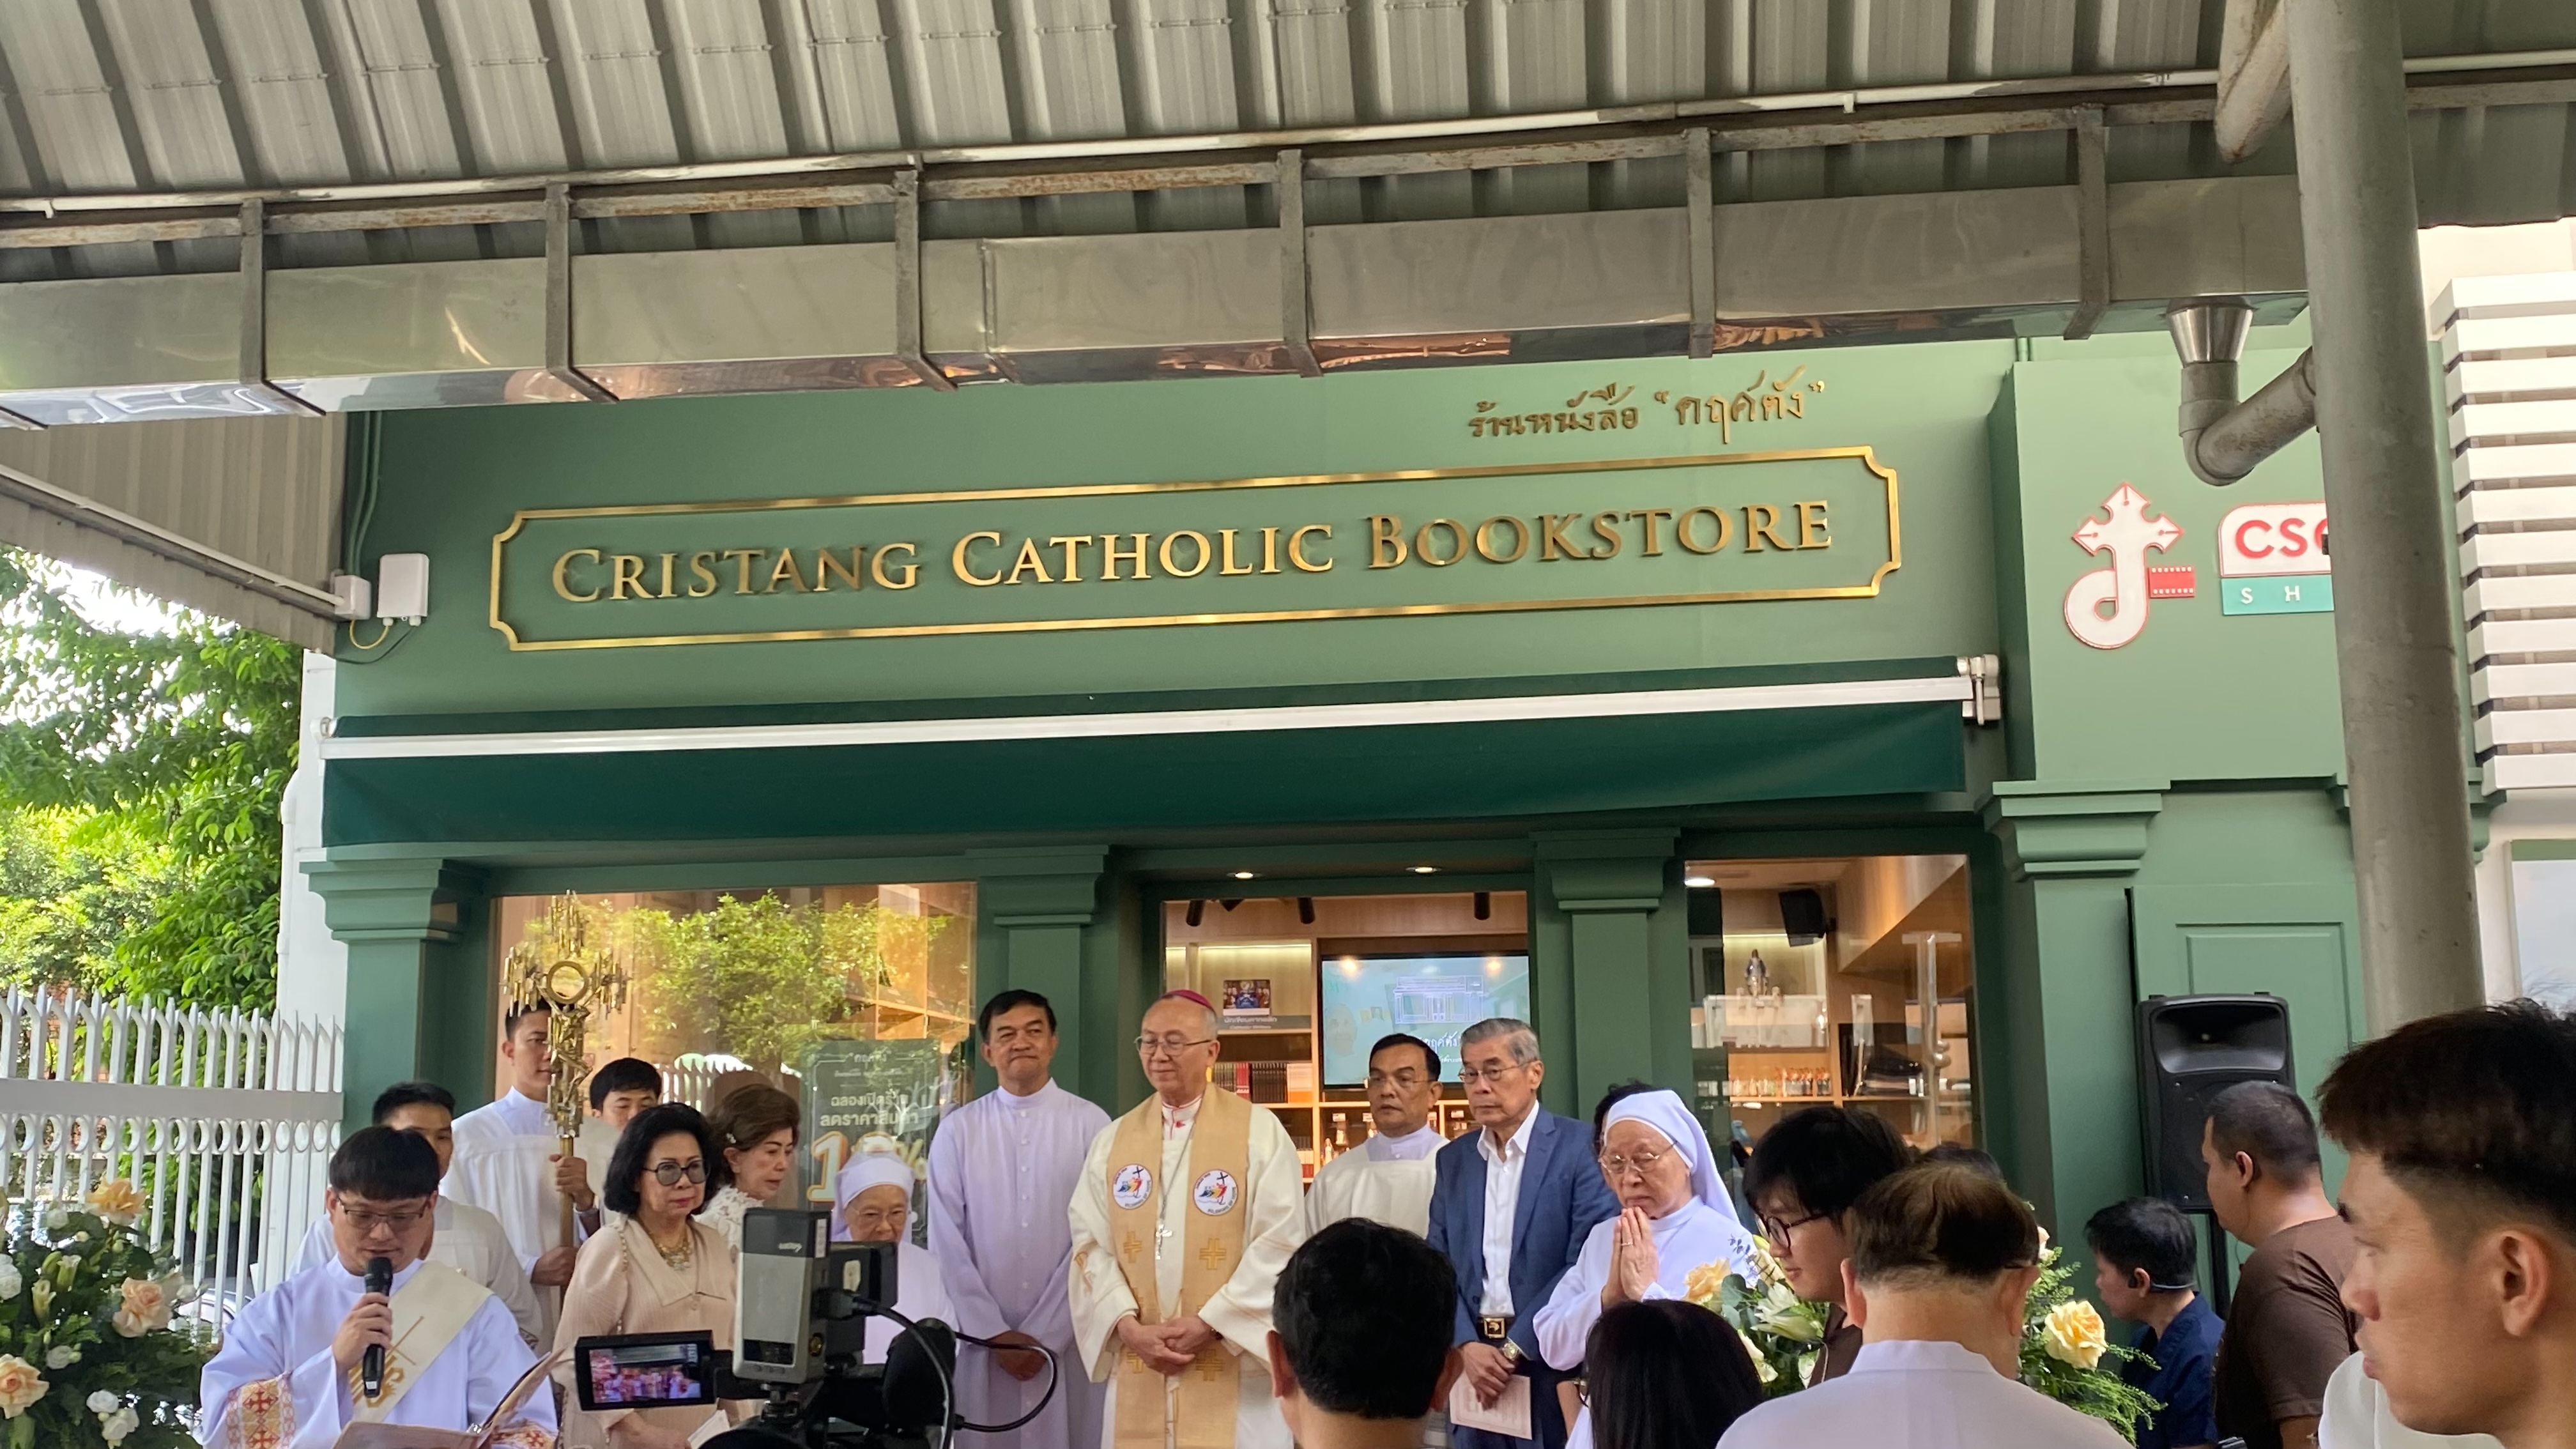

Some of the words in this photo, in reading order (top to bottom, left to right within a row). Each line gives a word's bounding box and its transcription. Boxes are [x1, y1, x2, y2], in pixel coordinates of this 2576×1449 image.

[1468, 382, 1639, 438] ร้านหนังสือ
[551, 542, 920, 602] CRISTANG
[951, 523, 1334, 586] CATHOLIC
[1365, 499, 1833, 571] BOOKSTORE
[2240, 585, 2301, 604] SH
